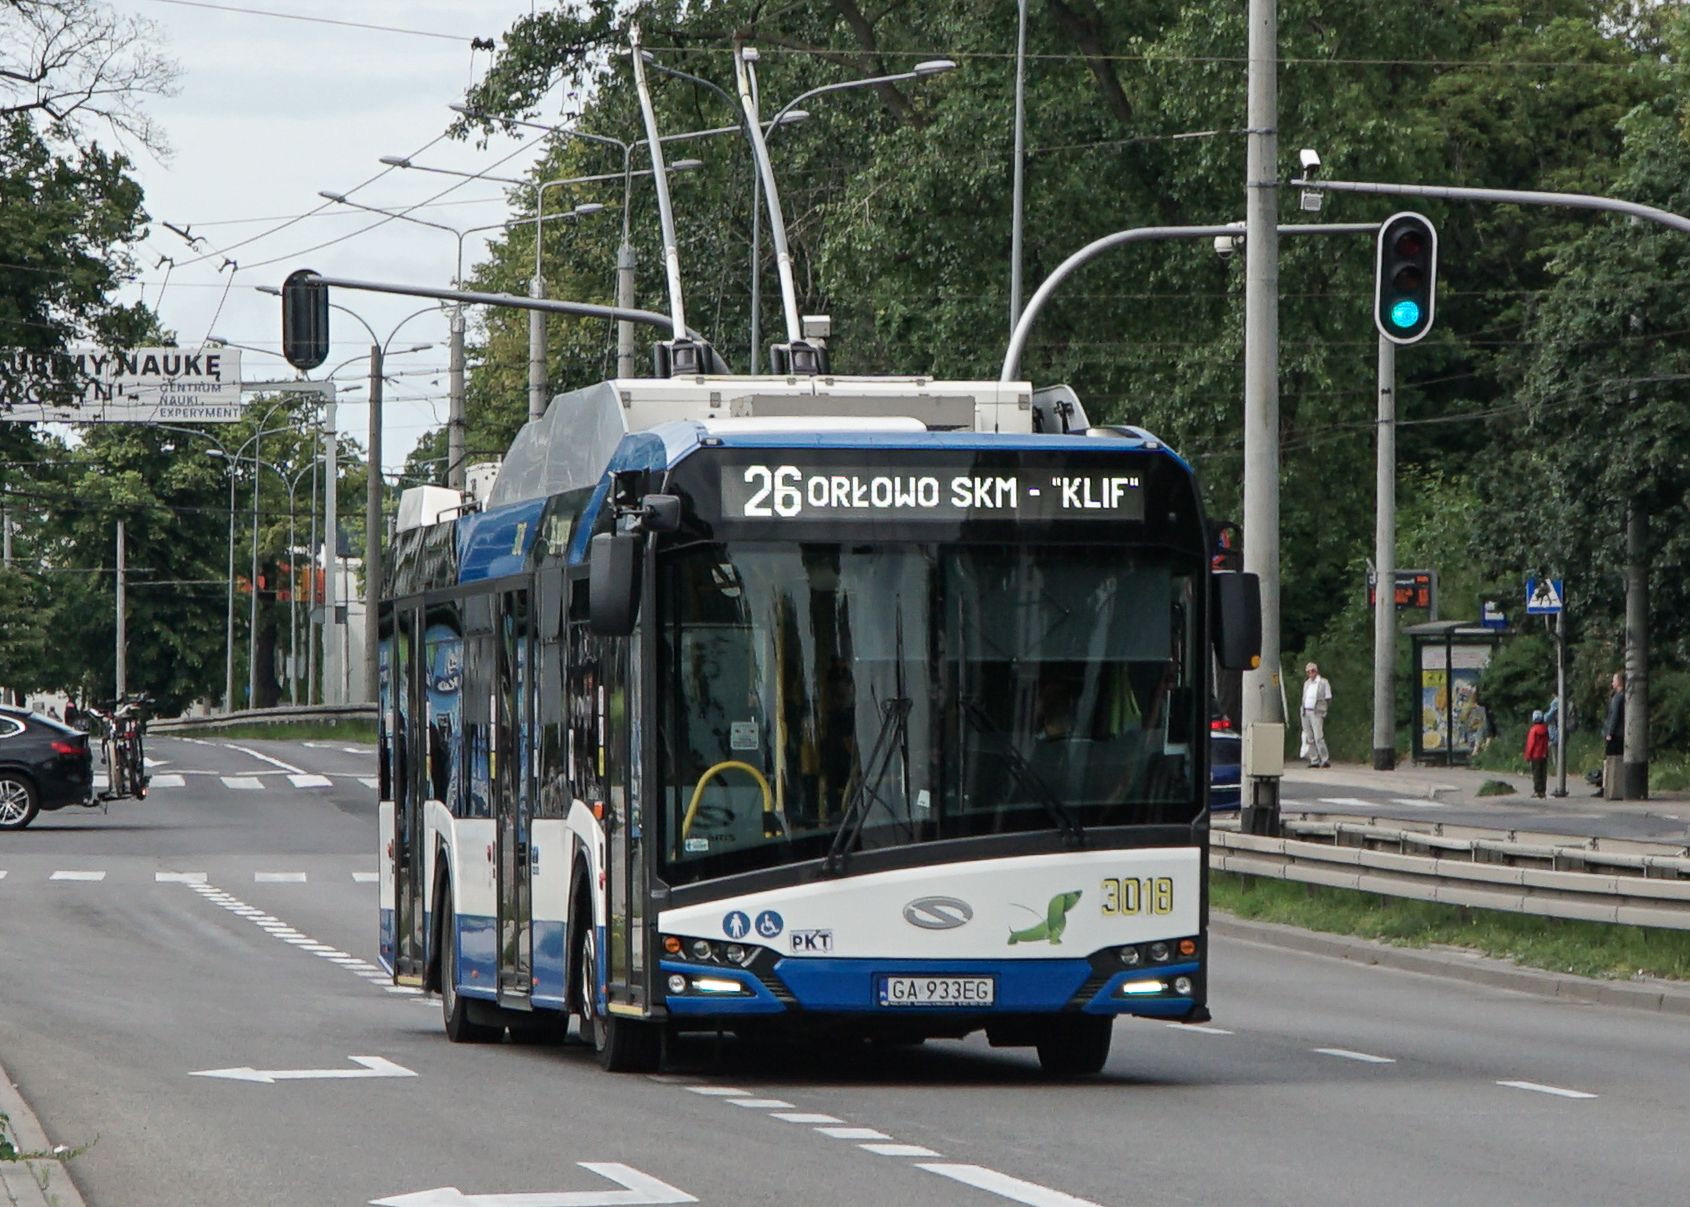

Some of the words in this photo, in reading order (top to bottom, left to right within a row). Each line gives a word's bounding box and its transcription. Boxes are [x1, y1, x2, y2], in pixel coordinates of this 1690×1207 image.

[118, 354, 220, 382] NAUKĘ
[160, 383, 221, 392] CENTRUM
[160, 395, 198, 406] NAUKI
[160, 408, 238, 418] EXPERYMENT
[744, 465, 802, 517] 26
[807, 477, 940, 508] ORŁOWO
[951, 477, 1018, 508] SKM
[1100, 878, 1173, 915] 3018
[793, 930, 830, 950] PKT
[892, 980, 918, 1000] GA
[926, 980, 989, 1000] 933EG
